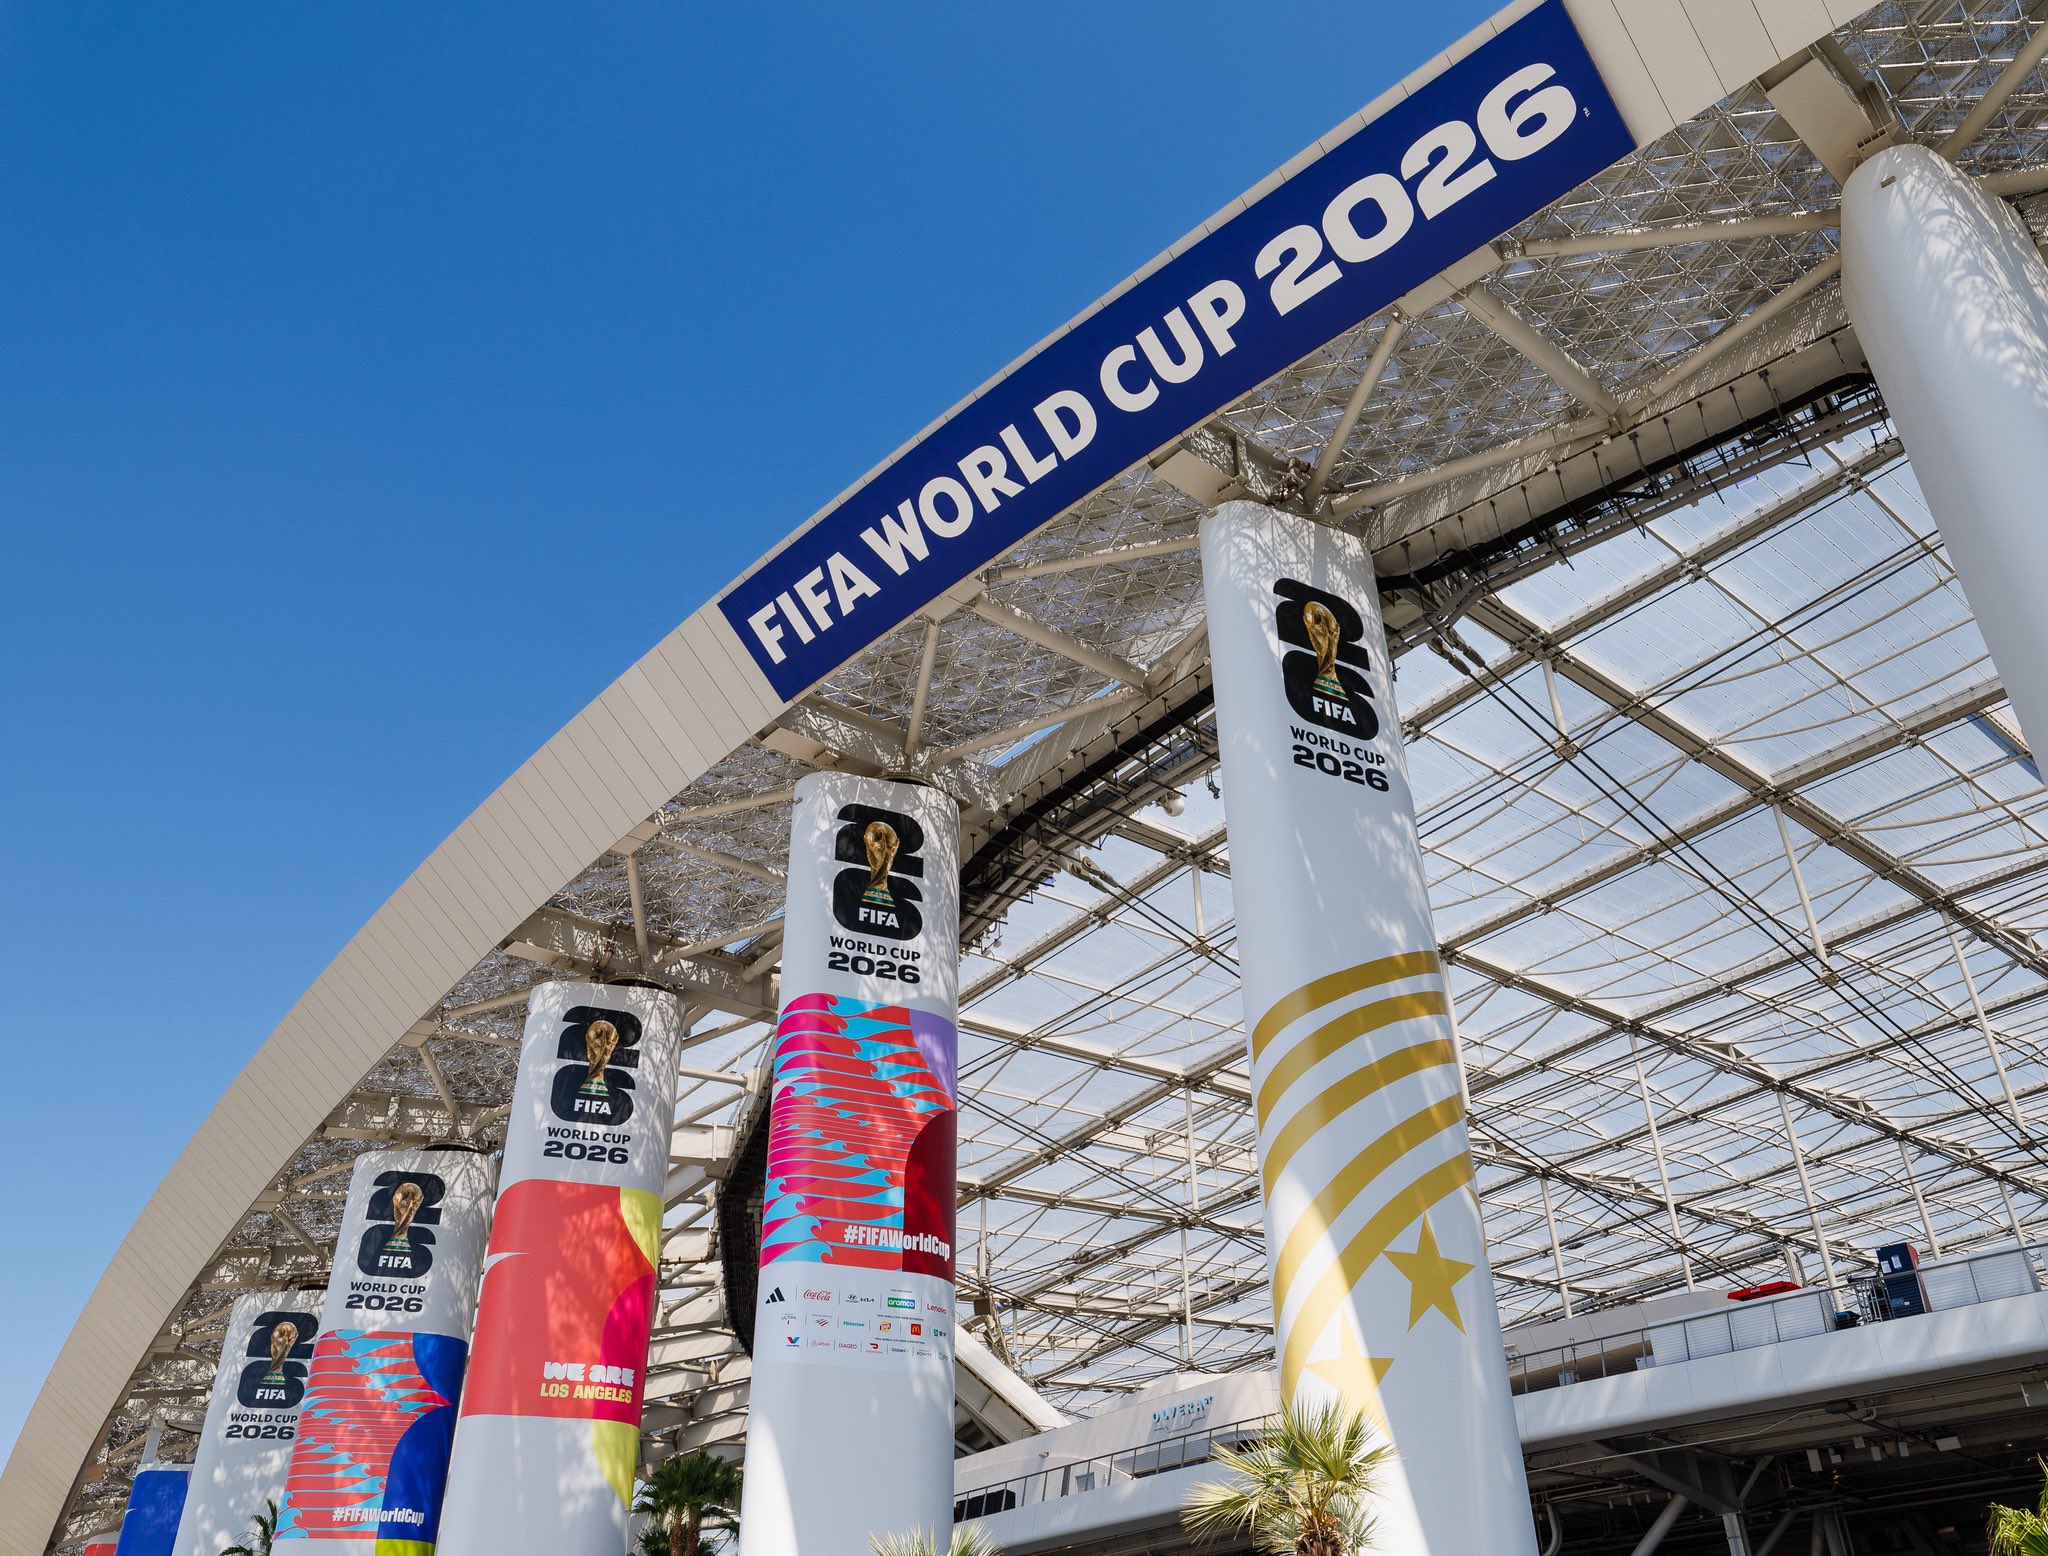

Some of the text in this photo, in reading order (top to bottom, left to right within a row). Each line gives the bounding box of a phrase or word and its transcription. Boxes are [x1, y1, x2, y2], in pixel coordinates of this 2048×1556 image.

[748, 63, 1576, 664] FIFA WORLD CUP 2026
[1312, 696, 1356, 725] FIFA
[1290, 725, 1385, 768] WORLD CUP
[1292, 744, 1389, 792] 2026
[858, 907, 899, 929] FIFA
[829, 935, 921, 962] WORLD CUP
[828, 951, 920, 984] 2026
[573, 1098, 611, 1115] FIFA
[547, 1127, 631, 1145] WORLD CUP
[543, 1140, 629, 1164] 2026
[844, 1224, 950, 1262] #FIFAWorldCup
[378, 1255, 412, 1269] FIFA
[350, 1281, 426, 1295] WORLD CUP
[345, 1293, 423, 1313] 2026
[888, 1300, 914, 1308] aramco
[926, 1303, 947, 1315] Lenovo
[543, 1361, 586, 1382] WE
[255, 1388, 286, 1400] FIFA
[540, 1382, 632, 1404] LOS ANGELES
[230, 1413, 298, 1424] WORLD CUP
[1152, 1399, 1205, 1423] OLVERA
[225, 1424, 295, 1440] 2026
[332, 1507, 425, 1526] #FIFAWorldCup
